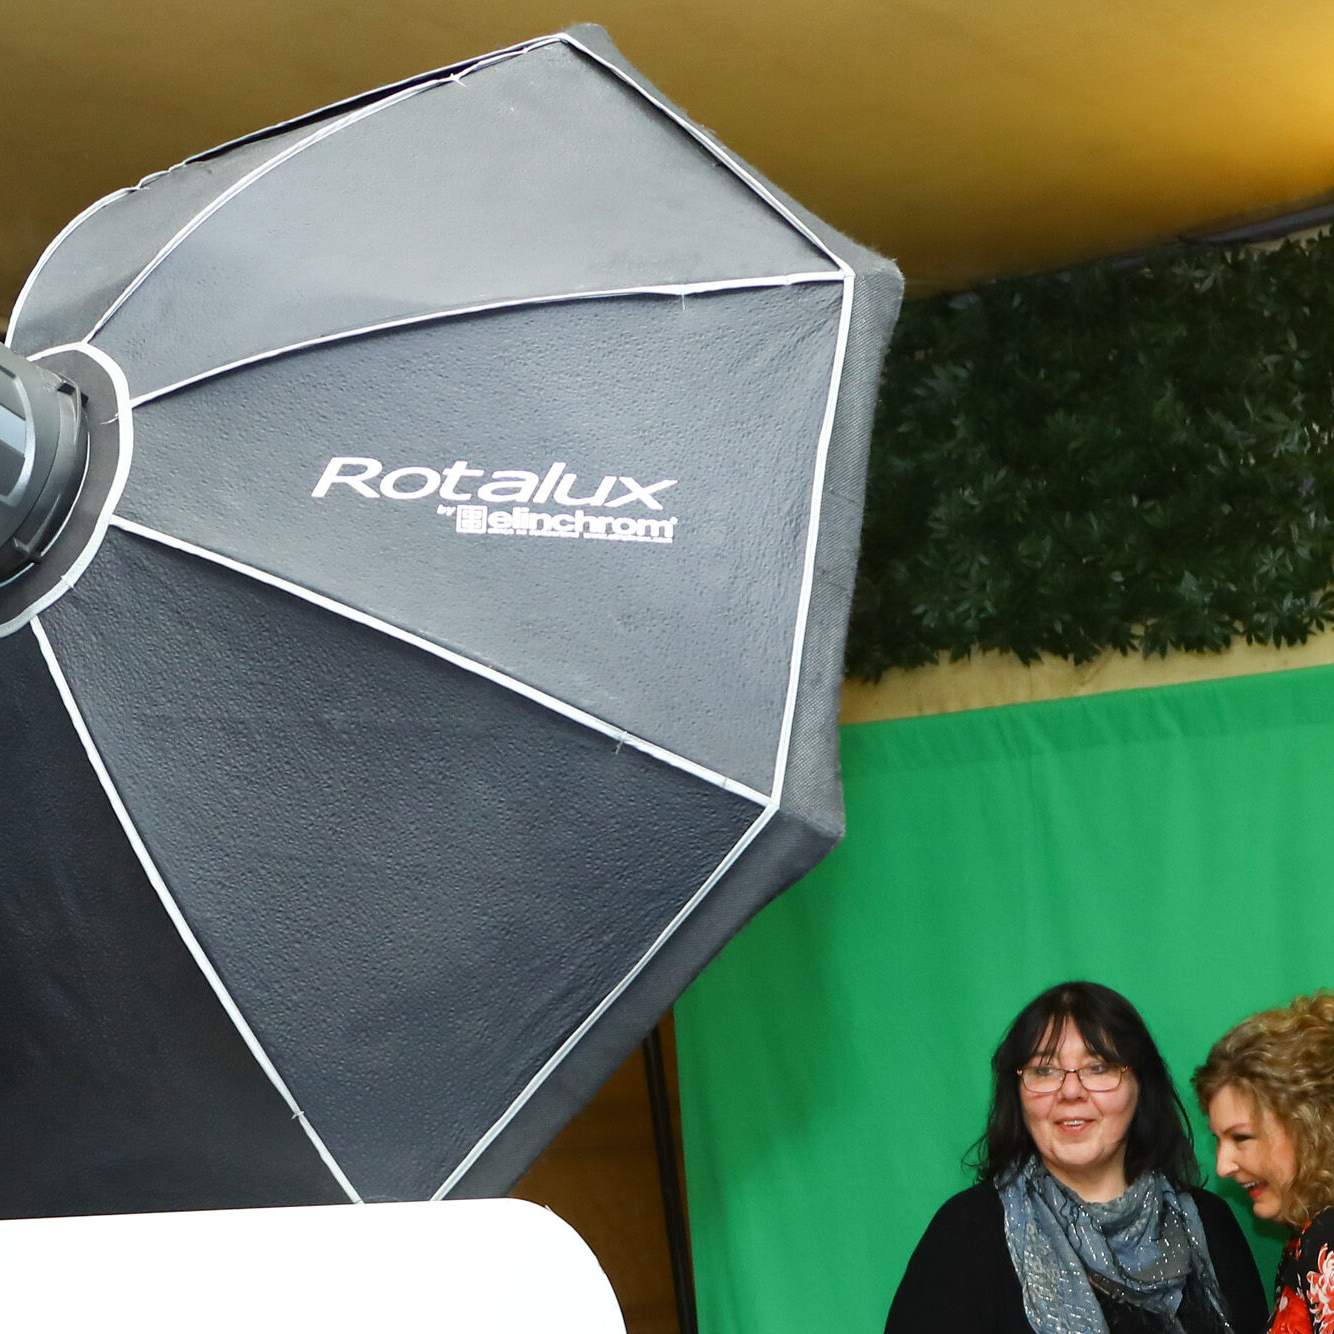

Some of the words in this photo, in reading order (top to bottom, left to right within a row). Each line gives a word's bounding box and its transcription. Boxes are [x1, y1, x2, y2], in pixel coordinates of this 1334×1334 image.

[311, 456, 678, 510] Rotalux
[436, 504, 456, 516] by
[487, 506, 675, 537] elinchrom
